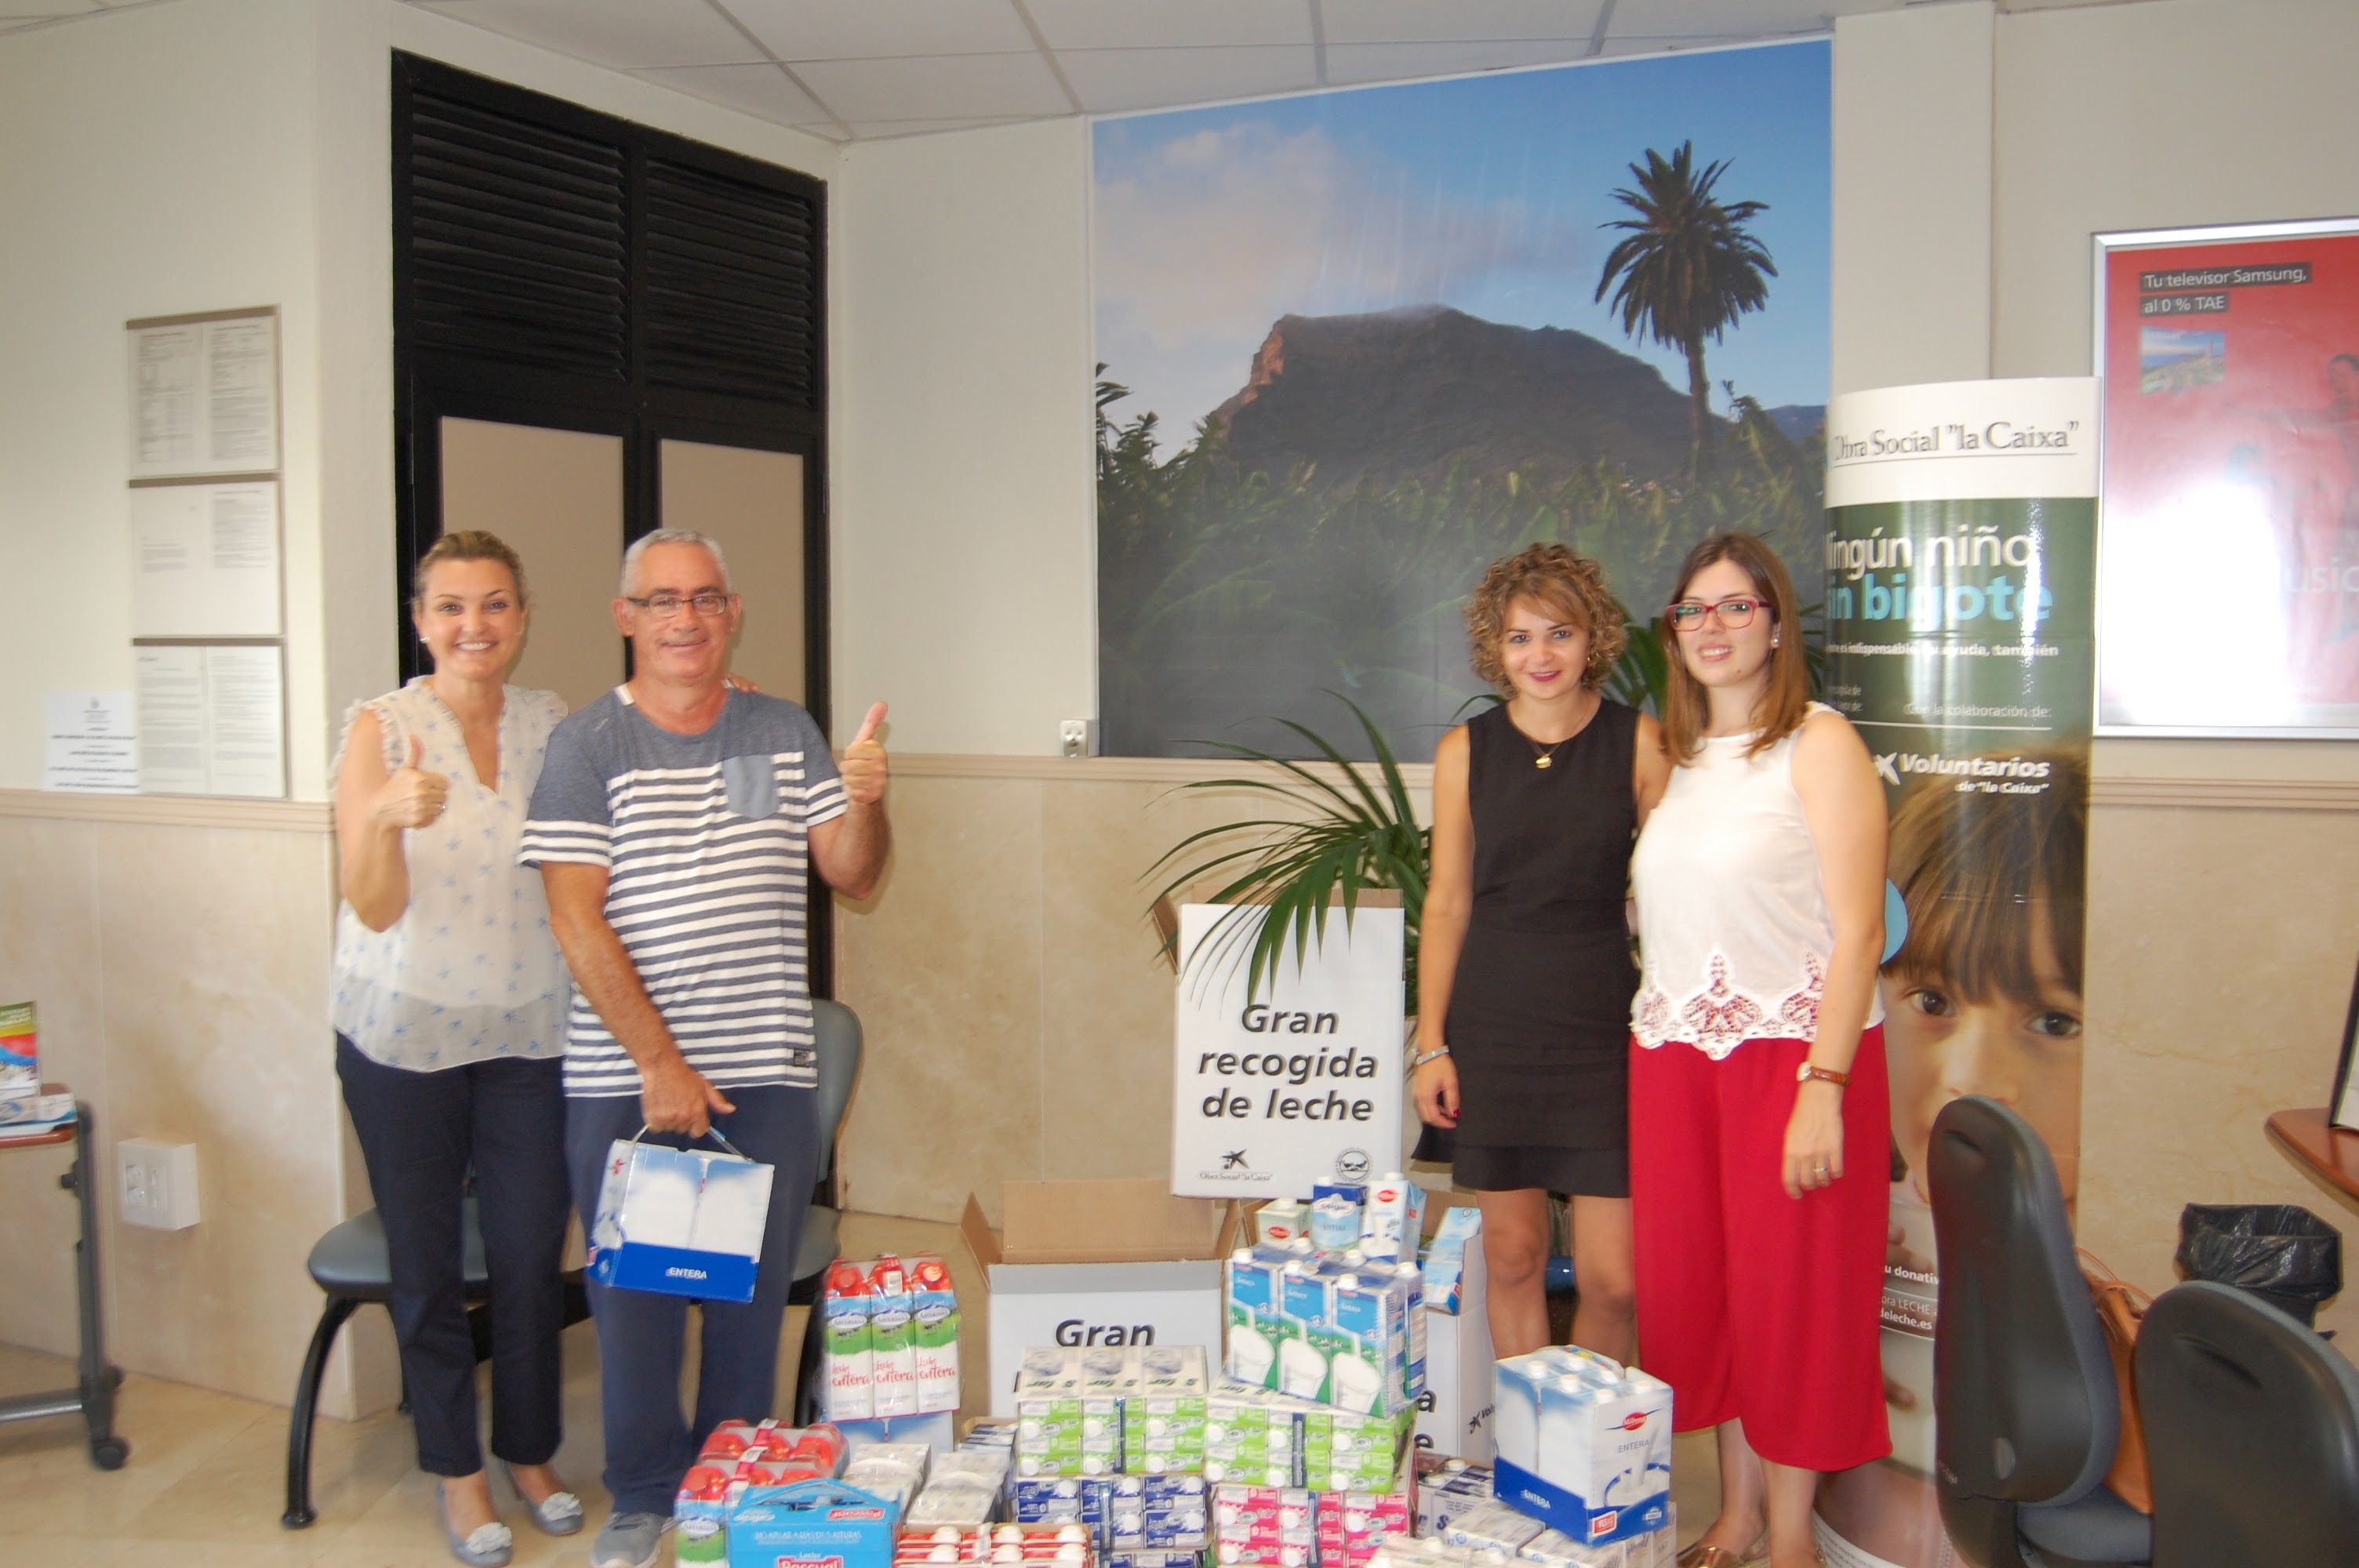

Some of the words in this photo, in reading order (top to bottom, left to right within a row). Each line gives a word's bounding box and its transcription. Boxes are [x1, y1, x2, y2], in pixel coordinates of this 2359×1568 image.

[2145, 274, 2163, 289] Tu
[2168, 270, 2230, 287] televisor
[2234, 267, 2307, 284] Samsung,
[2144, 299, 2157, 314] al
[2161, 299, 2172, 312] 0
[2175, 298, 2190, 311] %
[2195, 296, 2226, 310] TAE
[1873, 426, 1941, 455] Social
[1986, 420, 2080, 450] Caixa"
[1927, 524, 2034, 567] niño
[1861, 572, 2054, 633] bigote
[1941, 643, 1990, 659] ayuda,
[1903, 702, 1929, 715] Con
[1934, 702, 1943, 715] la
[1945, 703, 2027, 717] colaboración
[2032, 704, 2052, 717] de:
[1899, 753, 2051, 779] Voluntarios
[1954, 780, 1976, 793] de
[1241, 1004, 1340, 1035] Gran
[1198, 1047, 1379, 1085] recogida
[1201, 1087, 1253, 1119] de
[1265, 1087, 1376, 1122] leche
[667, 1266, 707, 1279] ENTERA
[1894, 1266, 1939, 1285] donativ
[1899, 1299, 1930, 1314] LECHE
[1056, 1319, 1157, 1347] Gran
[1618, 1439, 1650, 1454] ENTERA
[1521, 1489, 1551, 1509] ENTERA
